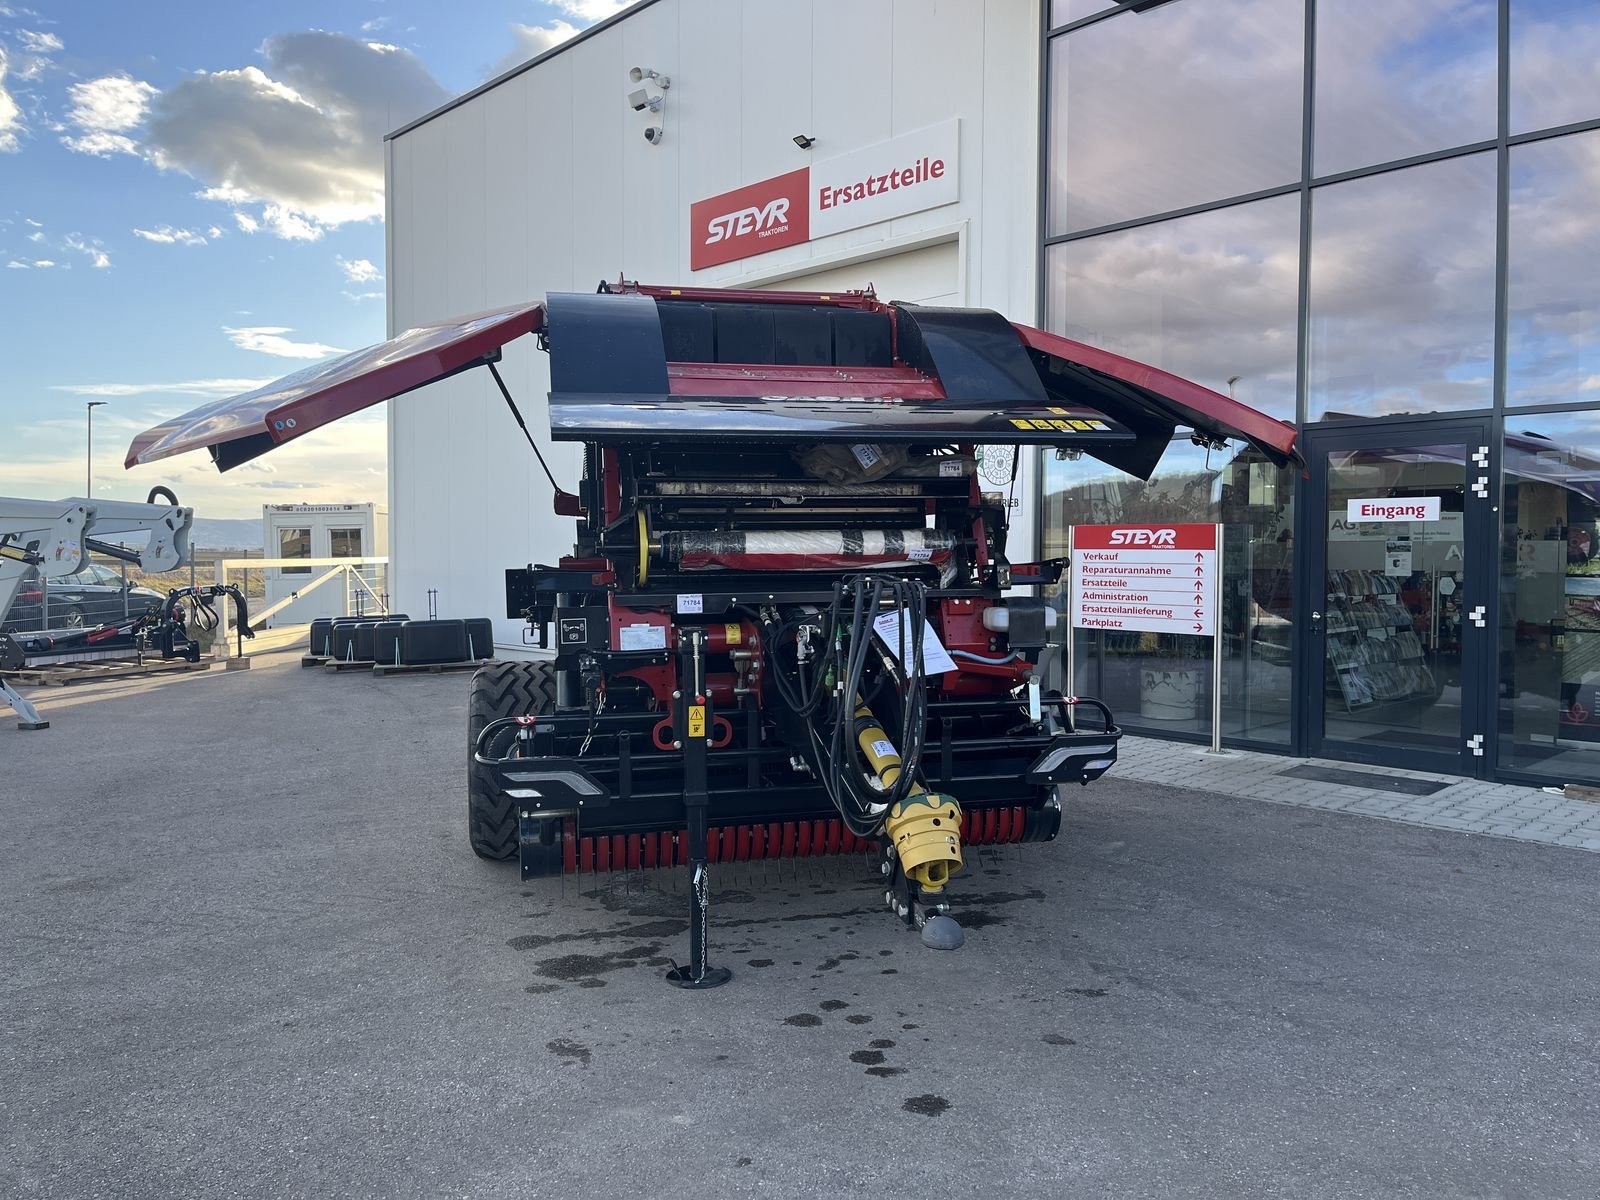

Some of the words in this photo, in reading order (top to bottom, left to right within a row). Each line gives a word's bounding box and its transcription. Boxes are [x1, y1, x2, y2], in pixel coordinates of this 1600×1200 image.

[820, 157, 945, 210] Ersatzteile
[705, 197, 790, 245] STEYR
[758, 224, 789, 238] TRAKTOREN
[1001, 498, 1019, 508] RIEB
[1361, 504, 1426, 519] Eingang
[1108, 529, 1177, 545] STEYR
[1083, 552, 1119, 561] Verkauf
[1082, 566, 1172, 576] Reparaturannahme
[1082, 579, 1128, 588] Ersatzteile
[1082, 592, 1149, 602] Administration
[1081, 604, 1173, 618] Ersatzteilanlieferung
[1081, 618, 1123, 629] Parkplatz
